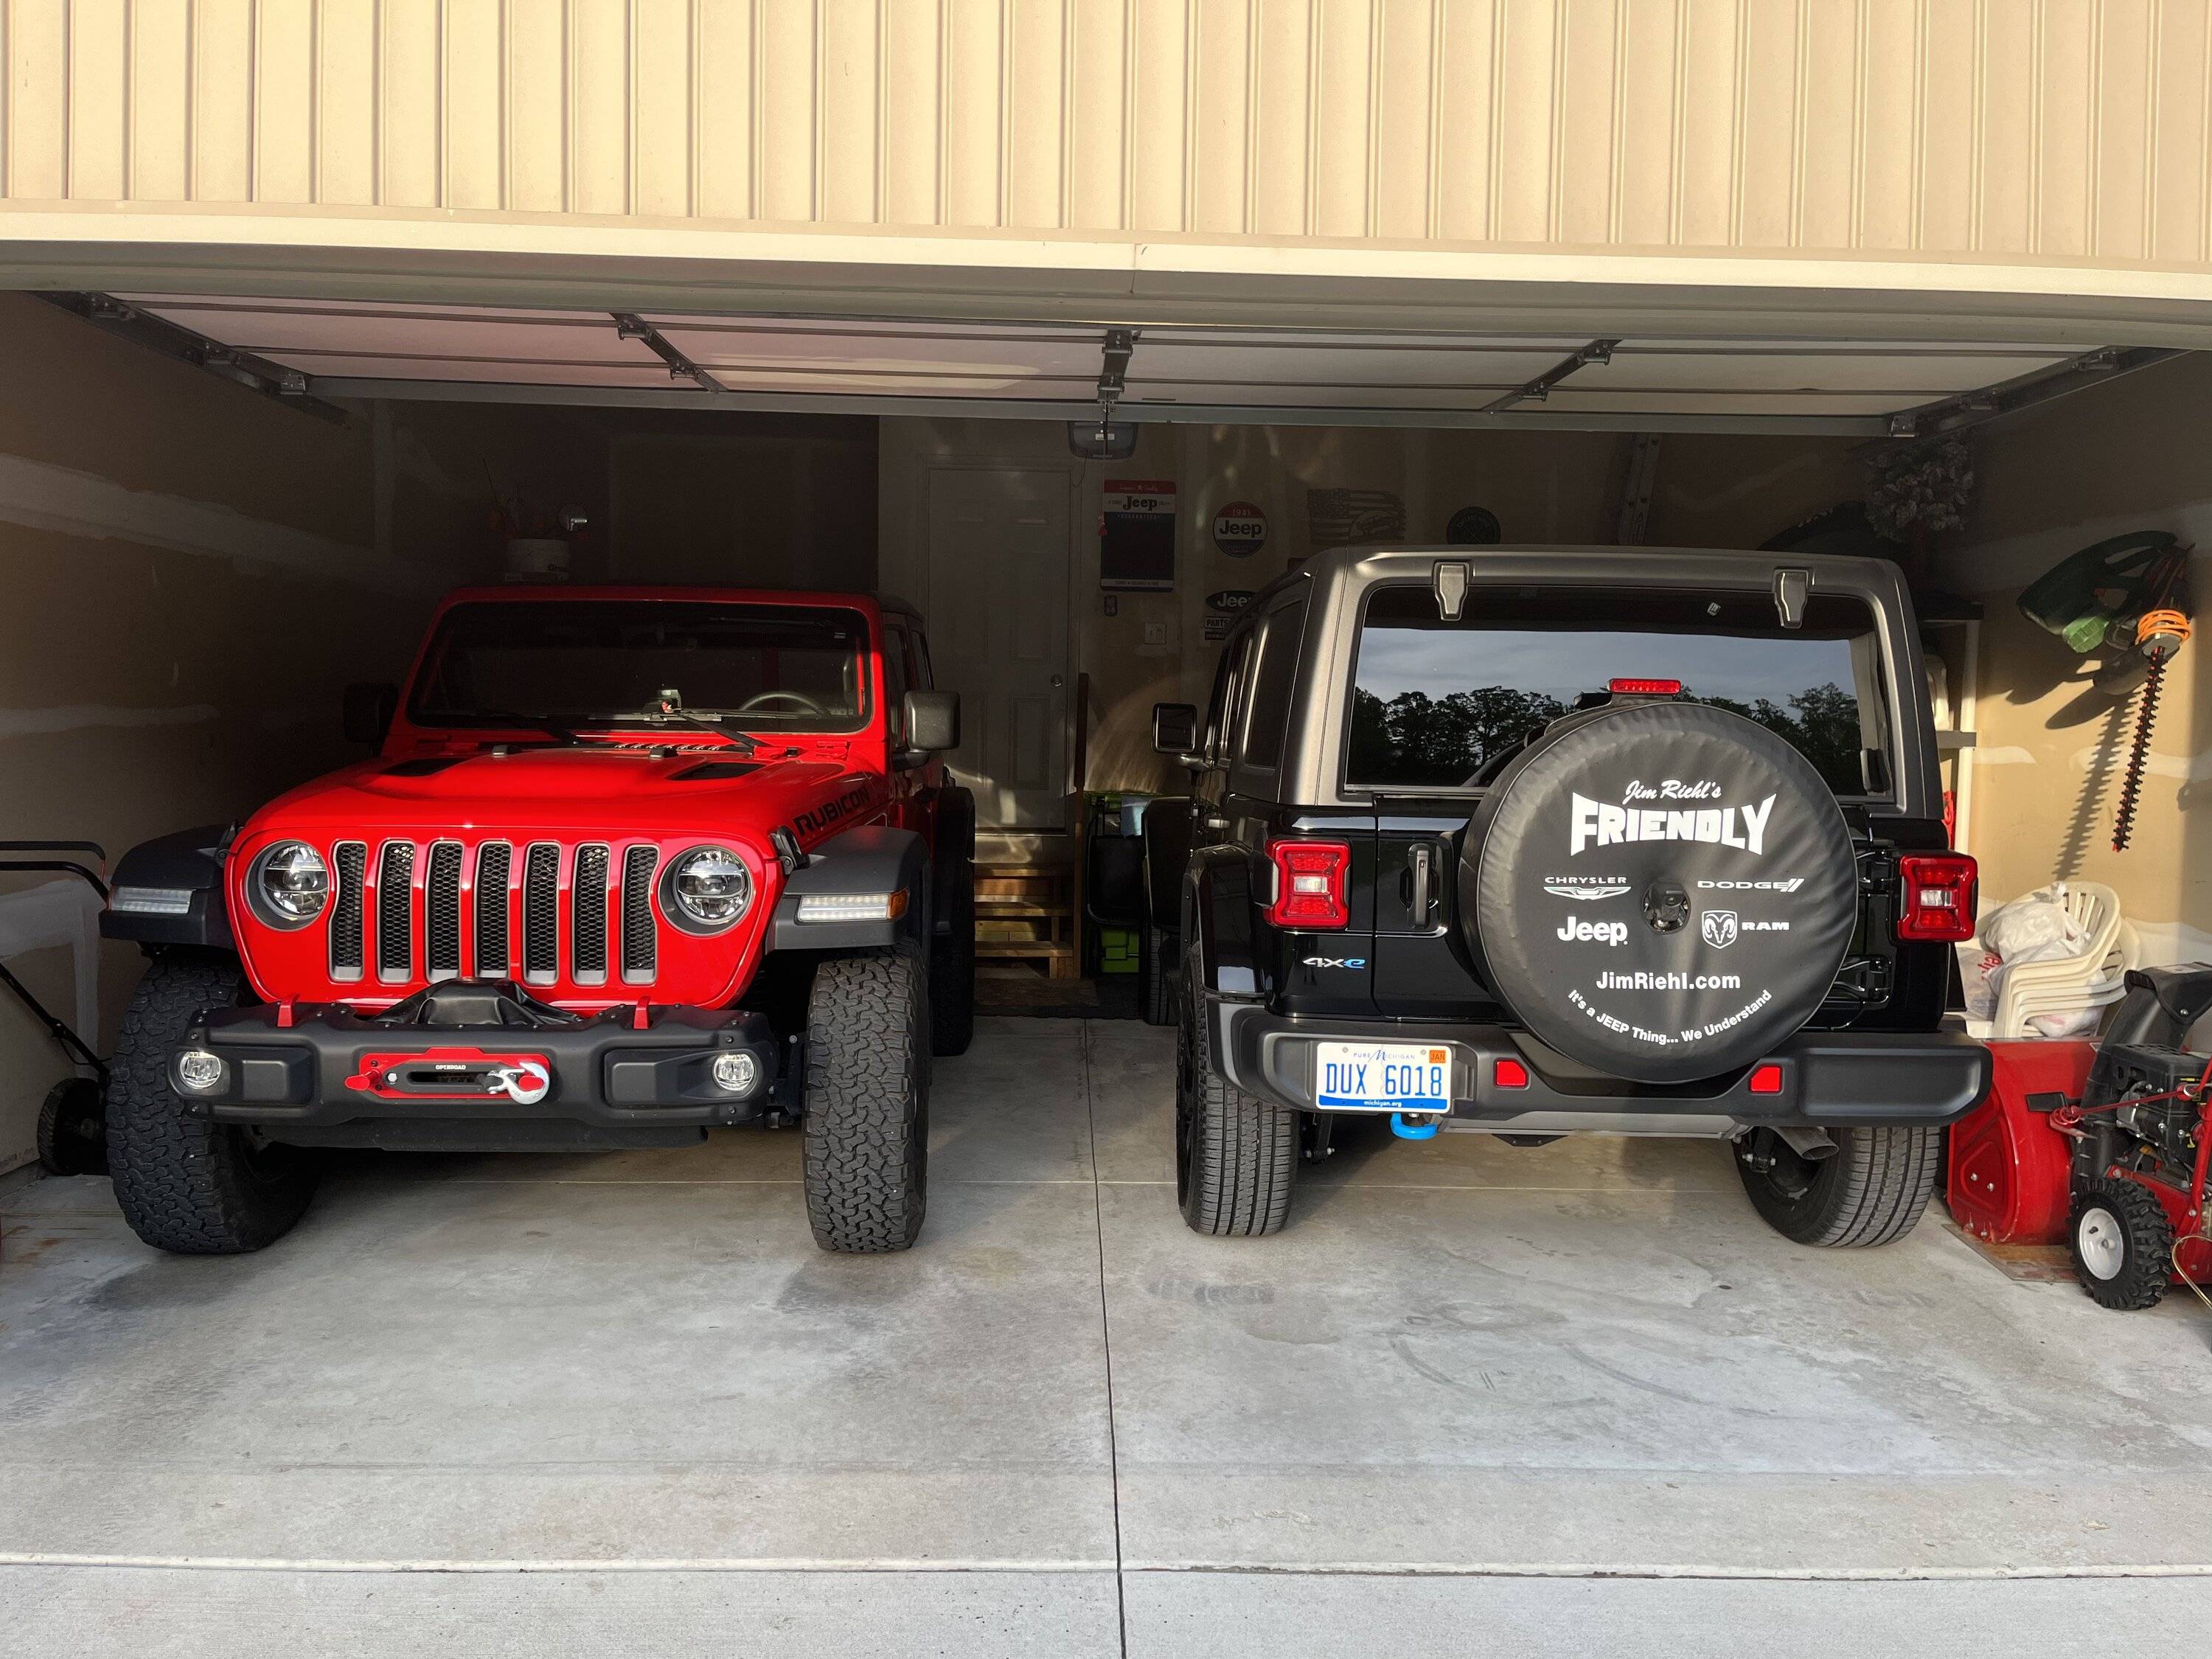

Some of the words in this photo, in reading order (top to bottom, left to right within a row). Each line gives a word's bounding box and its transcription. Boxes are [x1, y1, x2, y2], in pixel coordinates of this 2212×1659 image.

[1122, 495, 1158, 511] Jeep
[1232, 508, 1251, 516] 1941
[1219, 520, 1262, 538] Jeep
[1622, 779, 1658, 805] Jim
[1659, 779, 1722, 799] Riehl's
[793, 787, 871, 838] RUBICON
[1571, 792, 1777, 856] FRIENDLY
[1544, 876, 1627, 885] CHRYSLER
[1697, 880, 1788, 890] DODGE
[1557, 917, 1628, 947] Jeep
[1742, 922, 1790, 931] RAM
[1596, 971, 1741, 990] JimRiehl.com
[1568, 989, 1587, 1010] It's
[1586, 1006, 1596, 1018] a
[1596, 1012, 1630, 1034] JEEP
[1632, 1026, 1679, 1046] Thing...
[1680, 1029, 1703, 1043] We
[1704, 989, 1773, 1037] Understand
[1326, 1063, 1367, 1094] DUX
[1385, 1065, 1441, 1096] 6018
